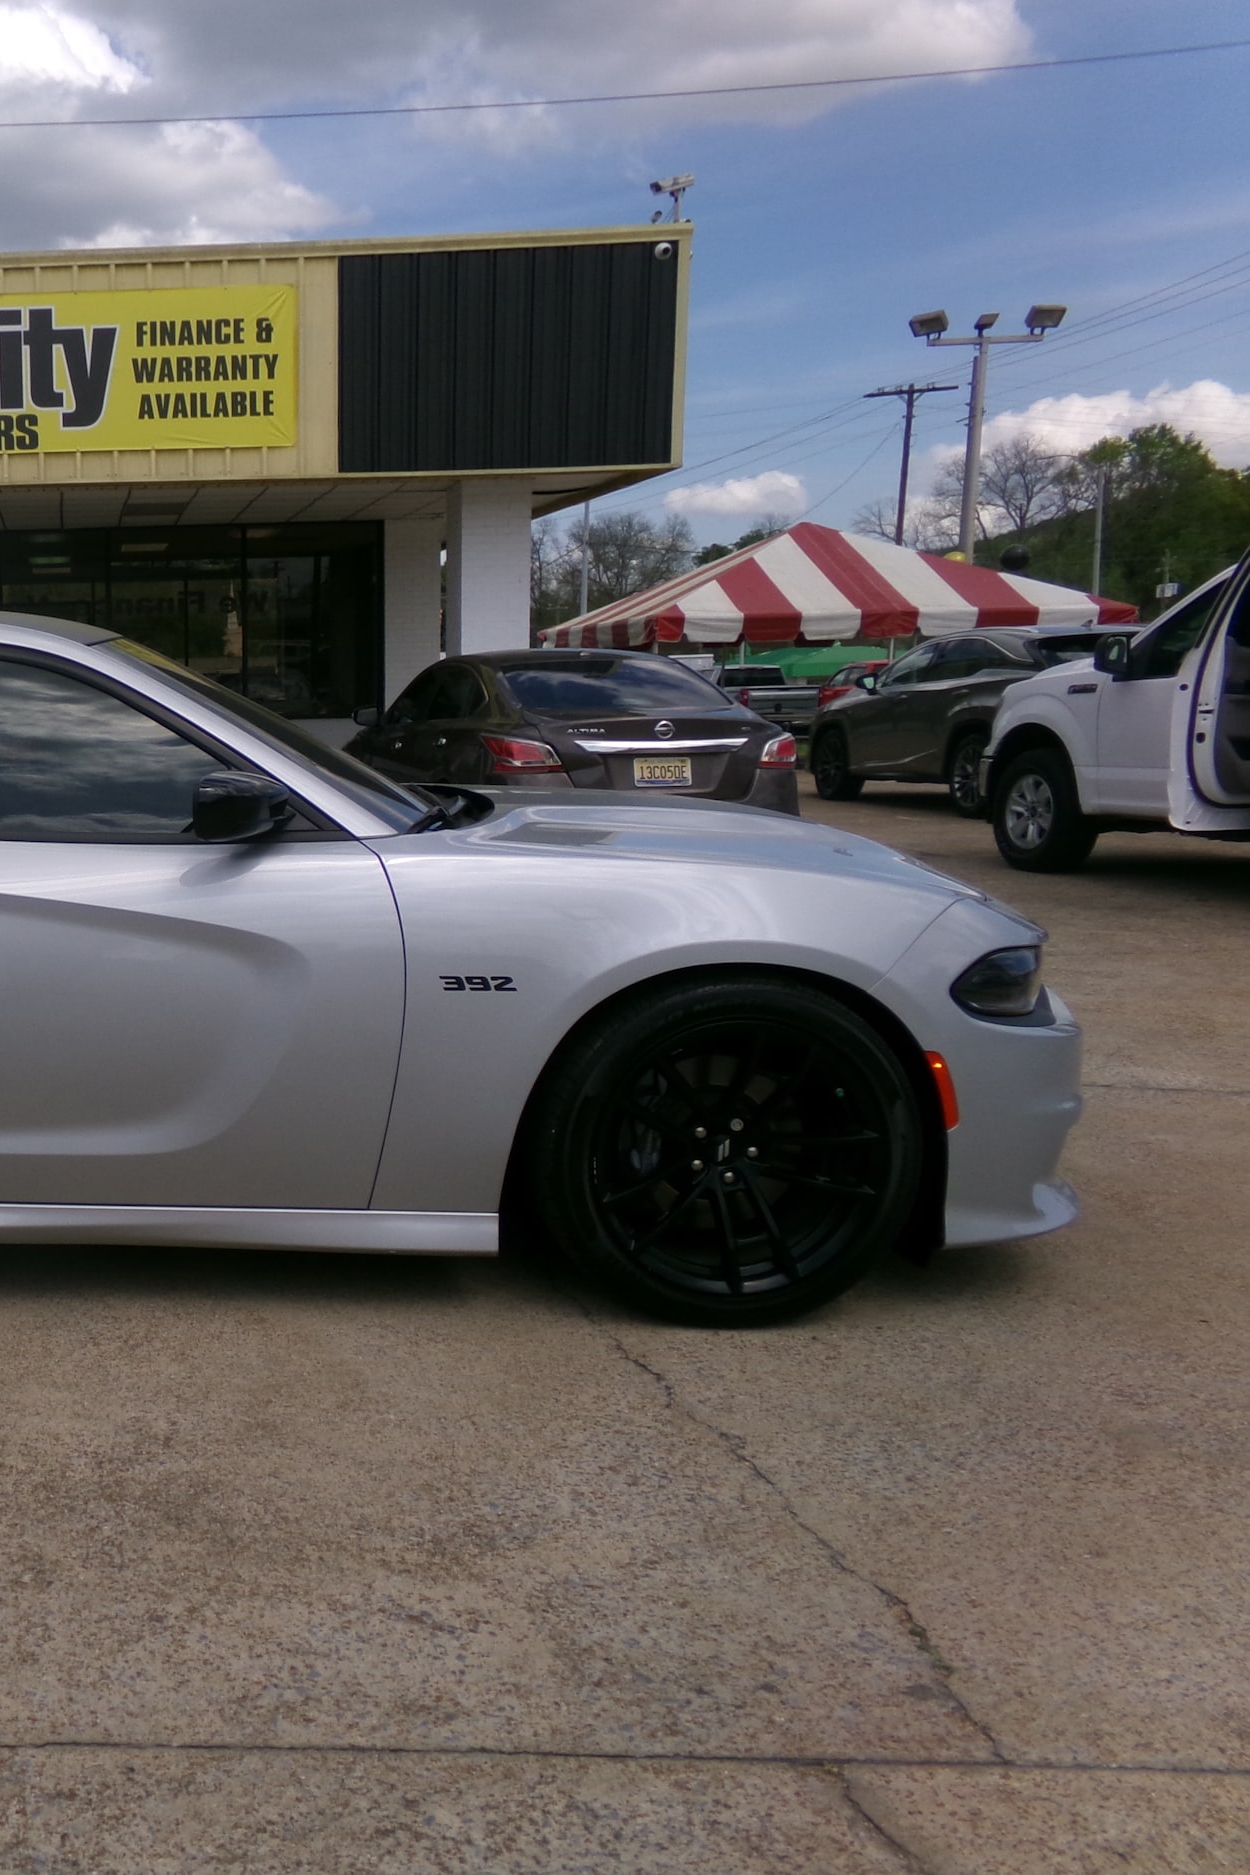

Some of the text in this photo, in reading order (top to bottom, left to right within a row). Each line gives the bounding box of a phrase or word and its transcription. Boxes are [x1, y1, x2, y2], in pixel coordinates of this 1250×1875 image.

[136, 317, 274, 347] FINANCE &
[132, 354, 279, 383] WARRANTY
[138, 390, 275, 420] AVAILABLE
[439, 975, 518, 992] 392
